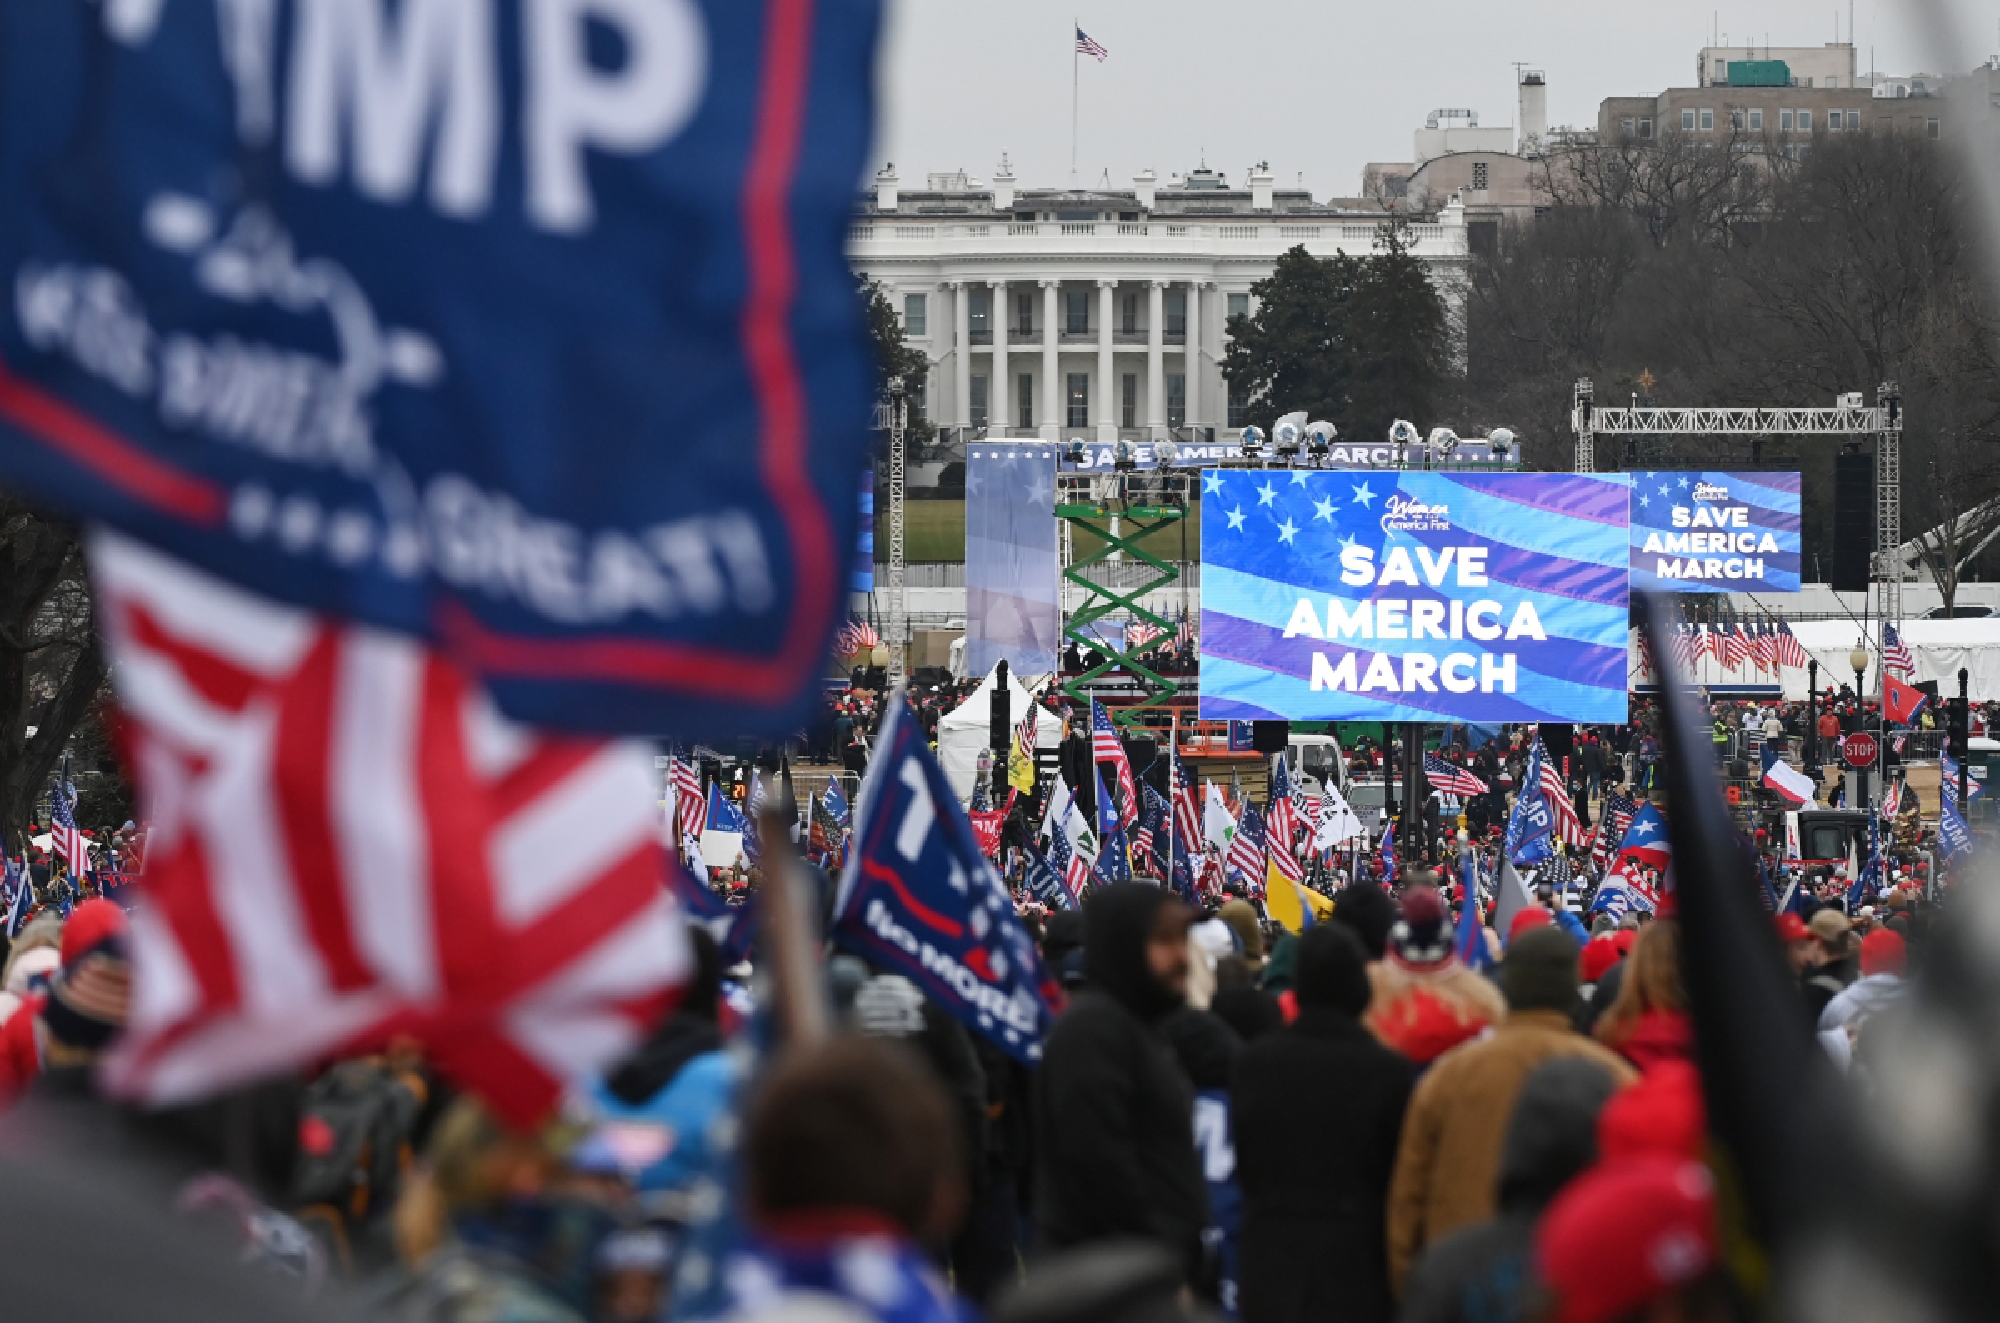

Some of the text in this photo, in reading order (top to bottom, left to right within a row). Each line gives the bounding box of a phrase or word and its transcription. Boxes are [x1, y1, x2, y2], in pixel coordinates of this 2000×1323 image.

[1077, 446, 1150, 468] SAE
[1671, 507, 1749, 528] SAVE
[1642, 532, 1779, 553] AMERICA
[1340, 546, 1489, 587] SAVE
[1657, 558, 1764, 579] MARCH
[1282, 598, 1548, 640] AMERICA
[1310, 651, 1518, 693] MARCH
[1846, 743, 1874, 756] STOP
